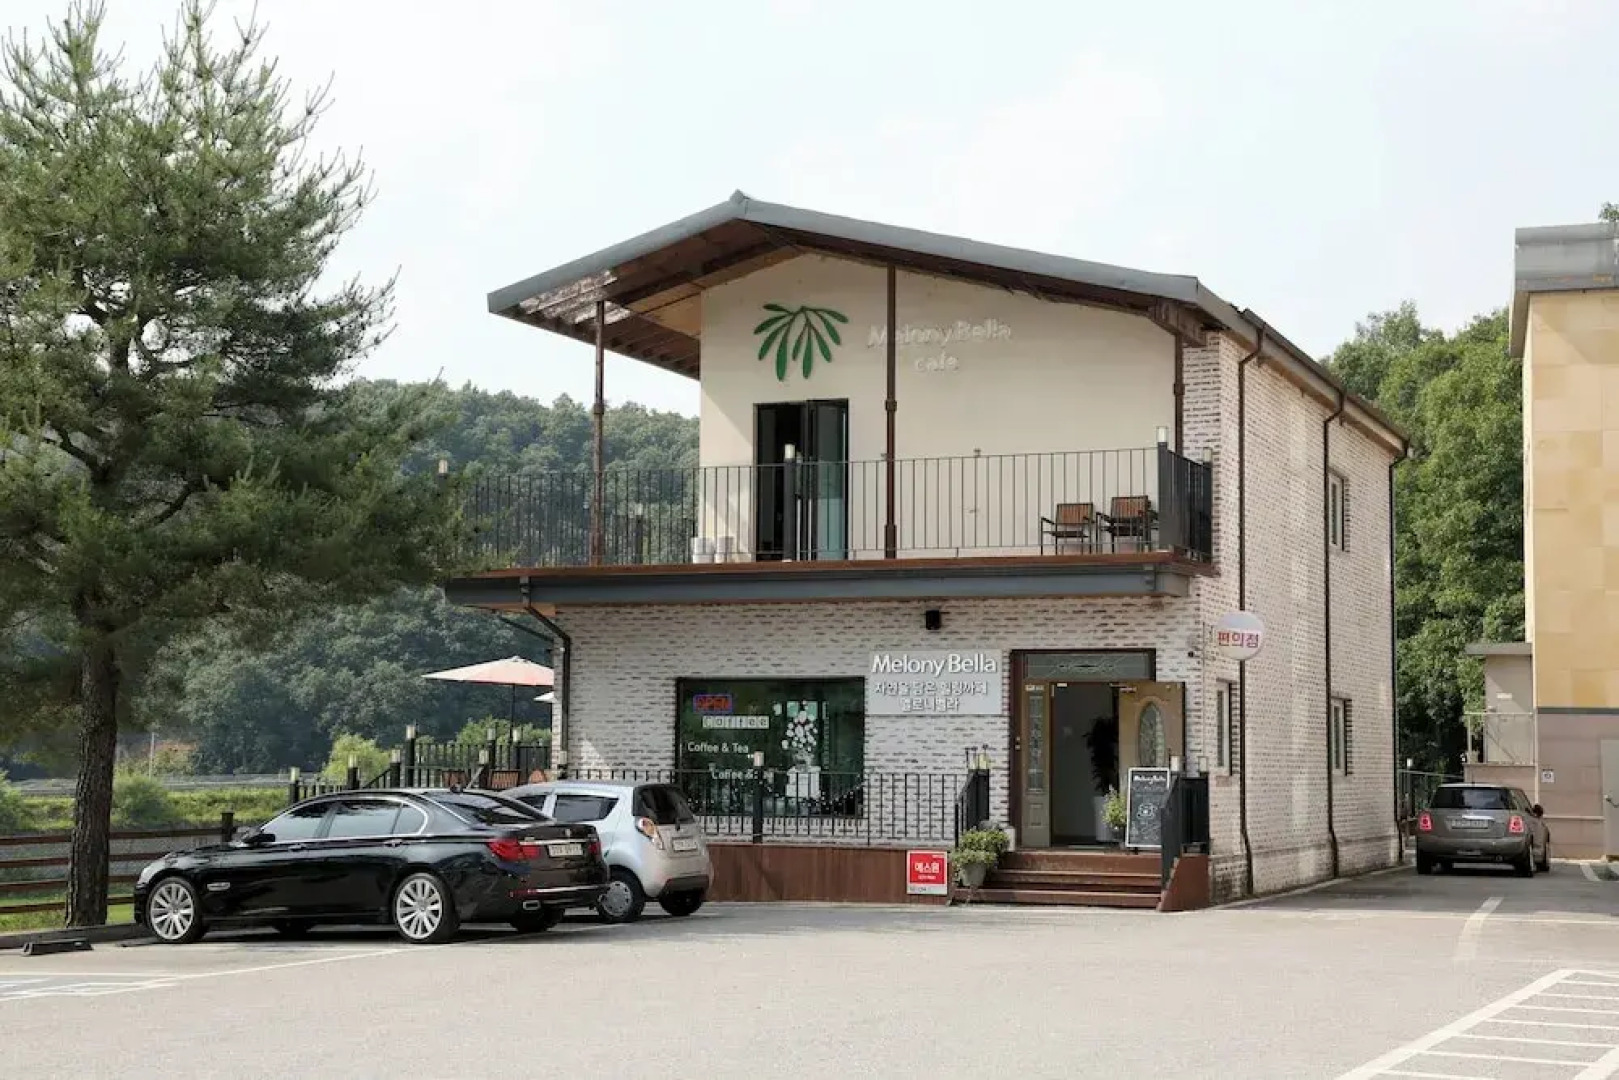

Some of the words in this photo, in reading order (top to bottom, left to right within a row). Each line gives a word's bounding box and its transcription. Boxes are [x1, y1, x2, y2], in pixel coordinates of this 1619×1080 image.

[1217, 631, 1259, 649] 편의점
[871, 653, 948, 678] Melony
[948, 653, 998, 673] Bella
[687, 742, 719, 753] Coffee
